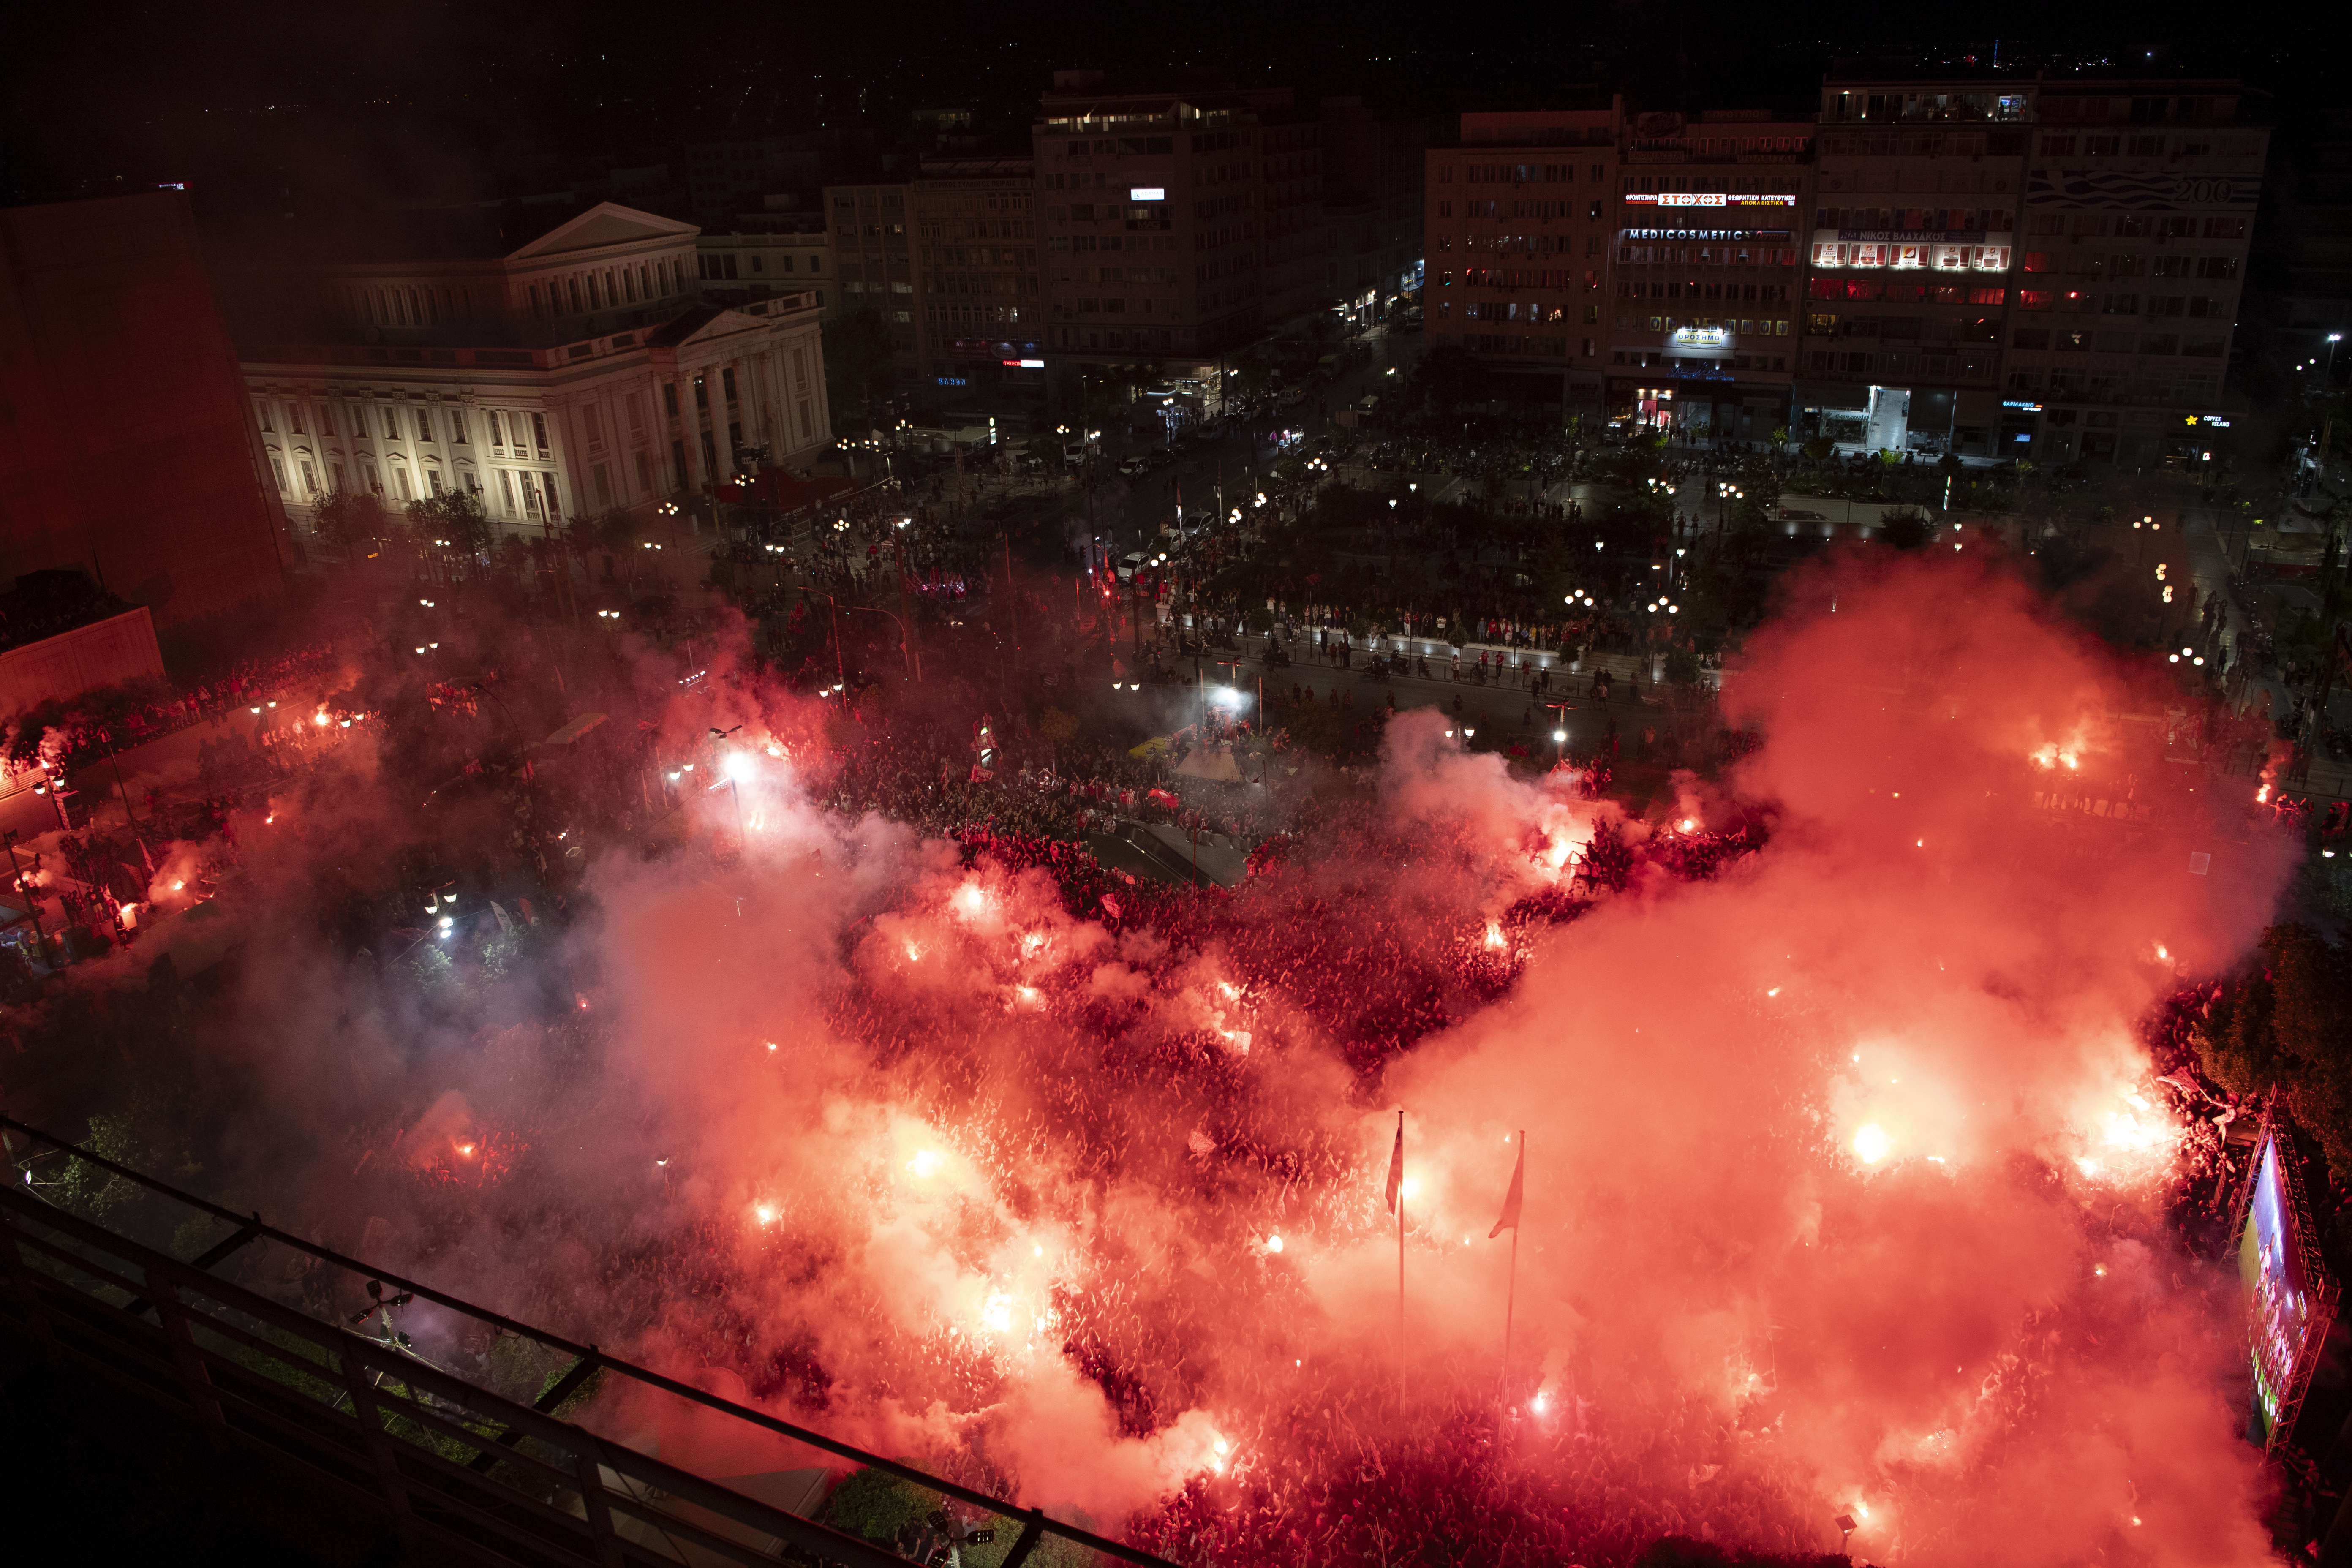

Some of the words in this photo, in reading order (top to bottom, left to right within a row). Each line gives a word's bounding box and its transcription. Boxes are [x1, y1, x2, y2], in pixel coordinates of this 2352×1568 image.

[2174, 181, 2232, 203] 200
[1662, 195, 1723, 205] ΣΤΟΧΟΣ
[1629, 229, 1742, 240] MEDICOSMETIC
